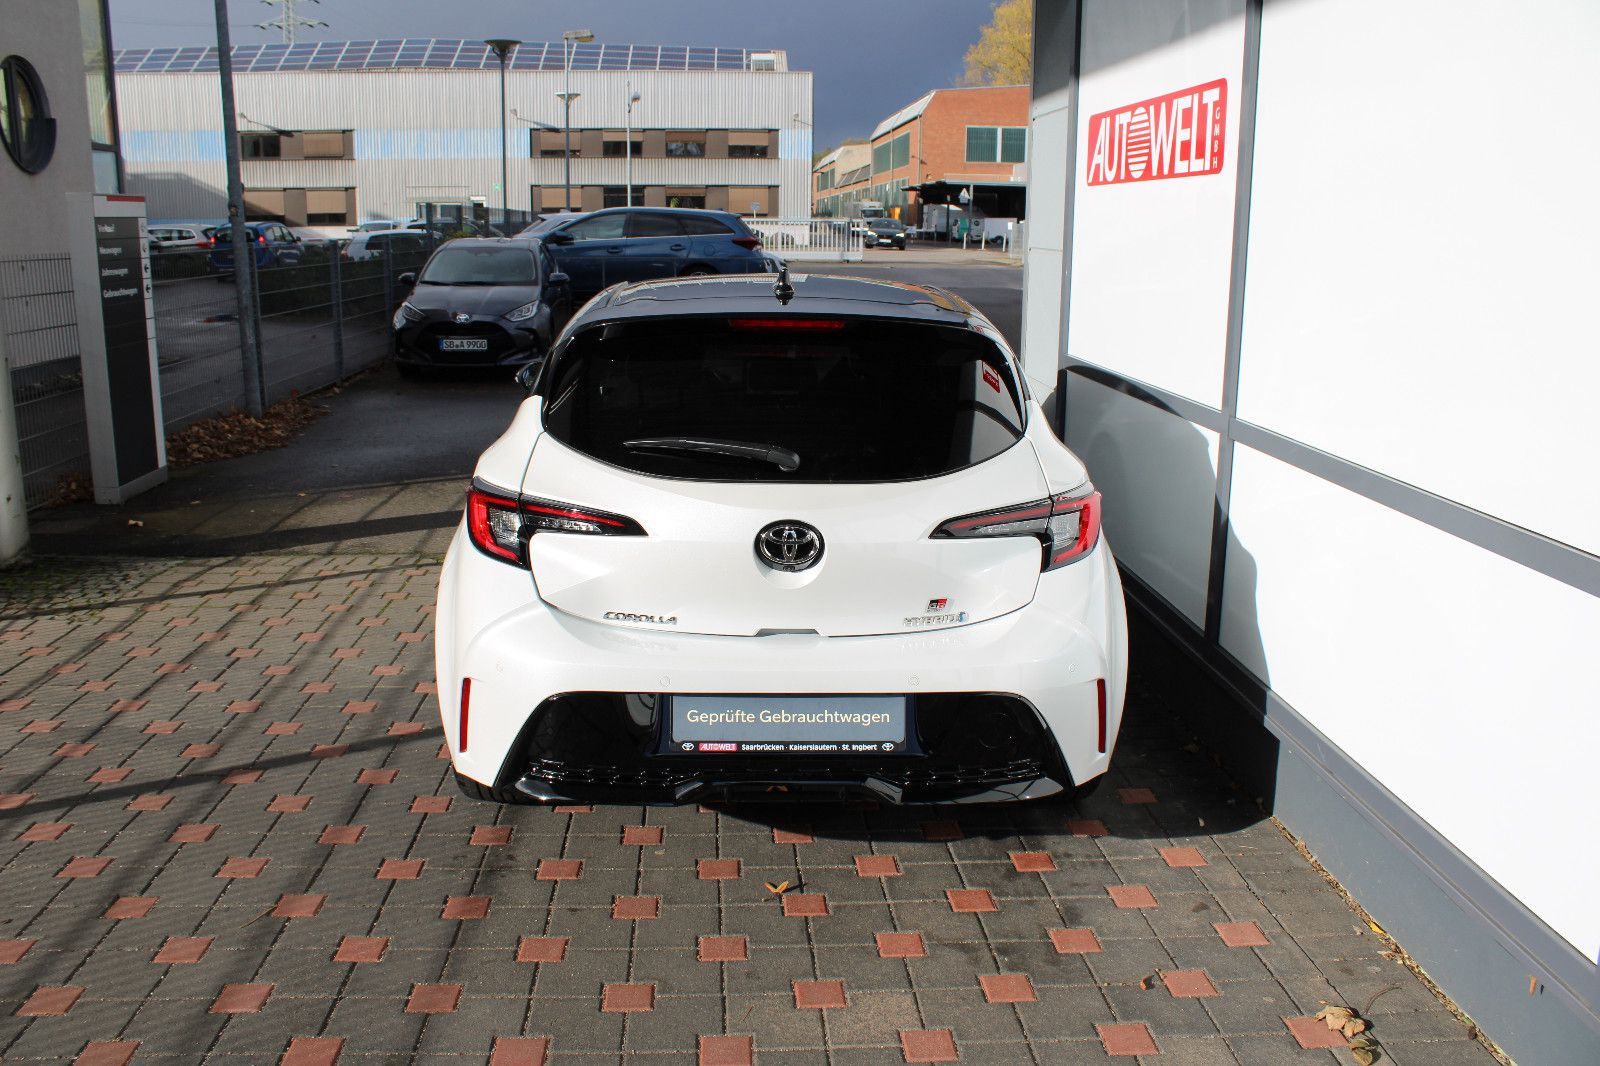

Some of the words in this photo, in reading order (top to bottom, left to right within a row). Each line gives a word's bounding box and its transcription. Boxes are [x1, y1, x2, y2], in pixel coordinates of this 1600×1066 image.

[1087, 87, 1220, 183] AUTOWELT
[103, 287, 138, 298] Gebrauchtwagen
[466, 340, 487, 349] 9900
[603, 611, 678, 625] COROLLA
[903, 614, 958, 627] HYBRID
[686, 709, 756, 726] Geprüfte
[759, 709, 890, 726] Gebrauchtwagen
[699, 742, 737, 752] AUTOWELT
[741, 743, 785, 751] Saarbrücken
[789, 743, 838, 751] Kaiserslautern
[841, 743, 851, 751] St.
[852, 743, 878, 752] Ingbert
